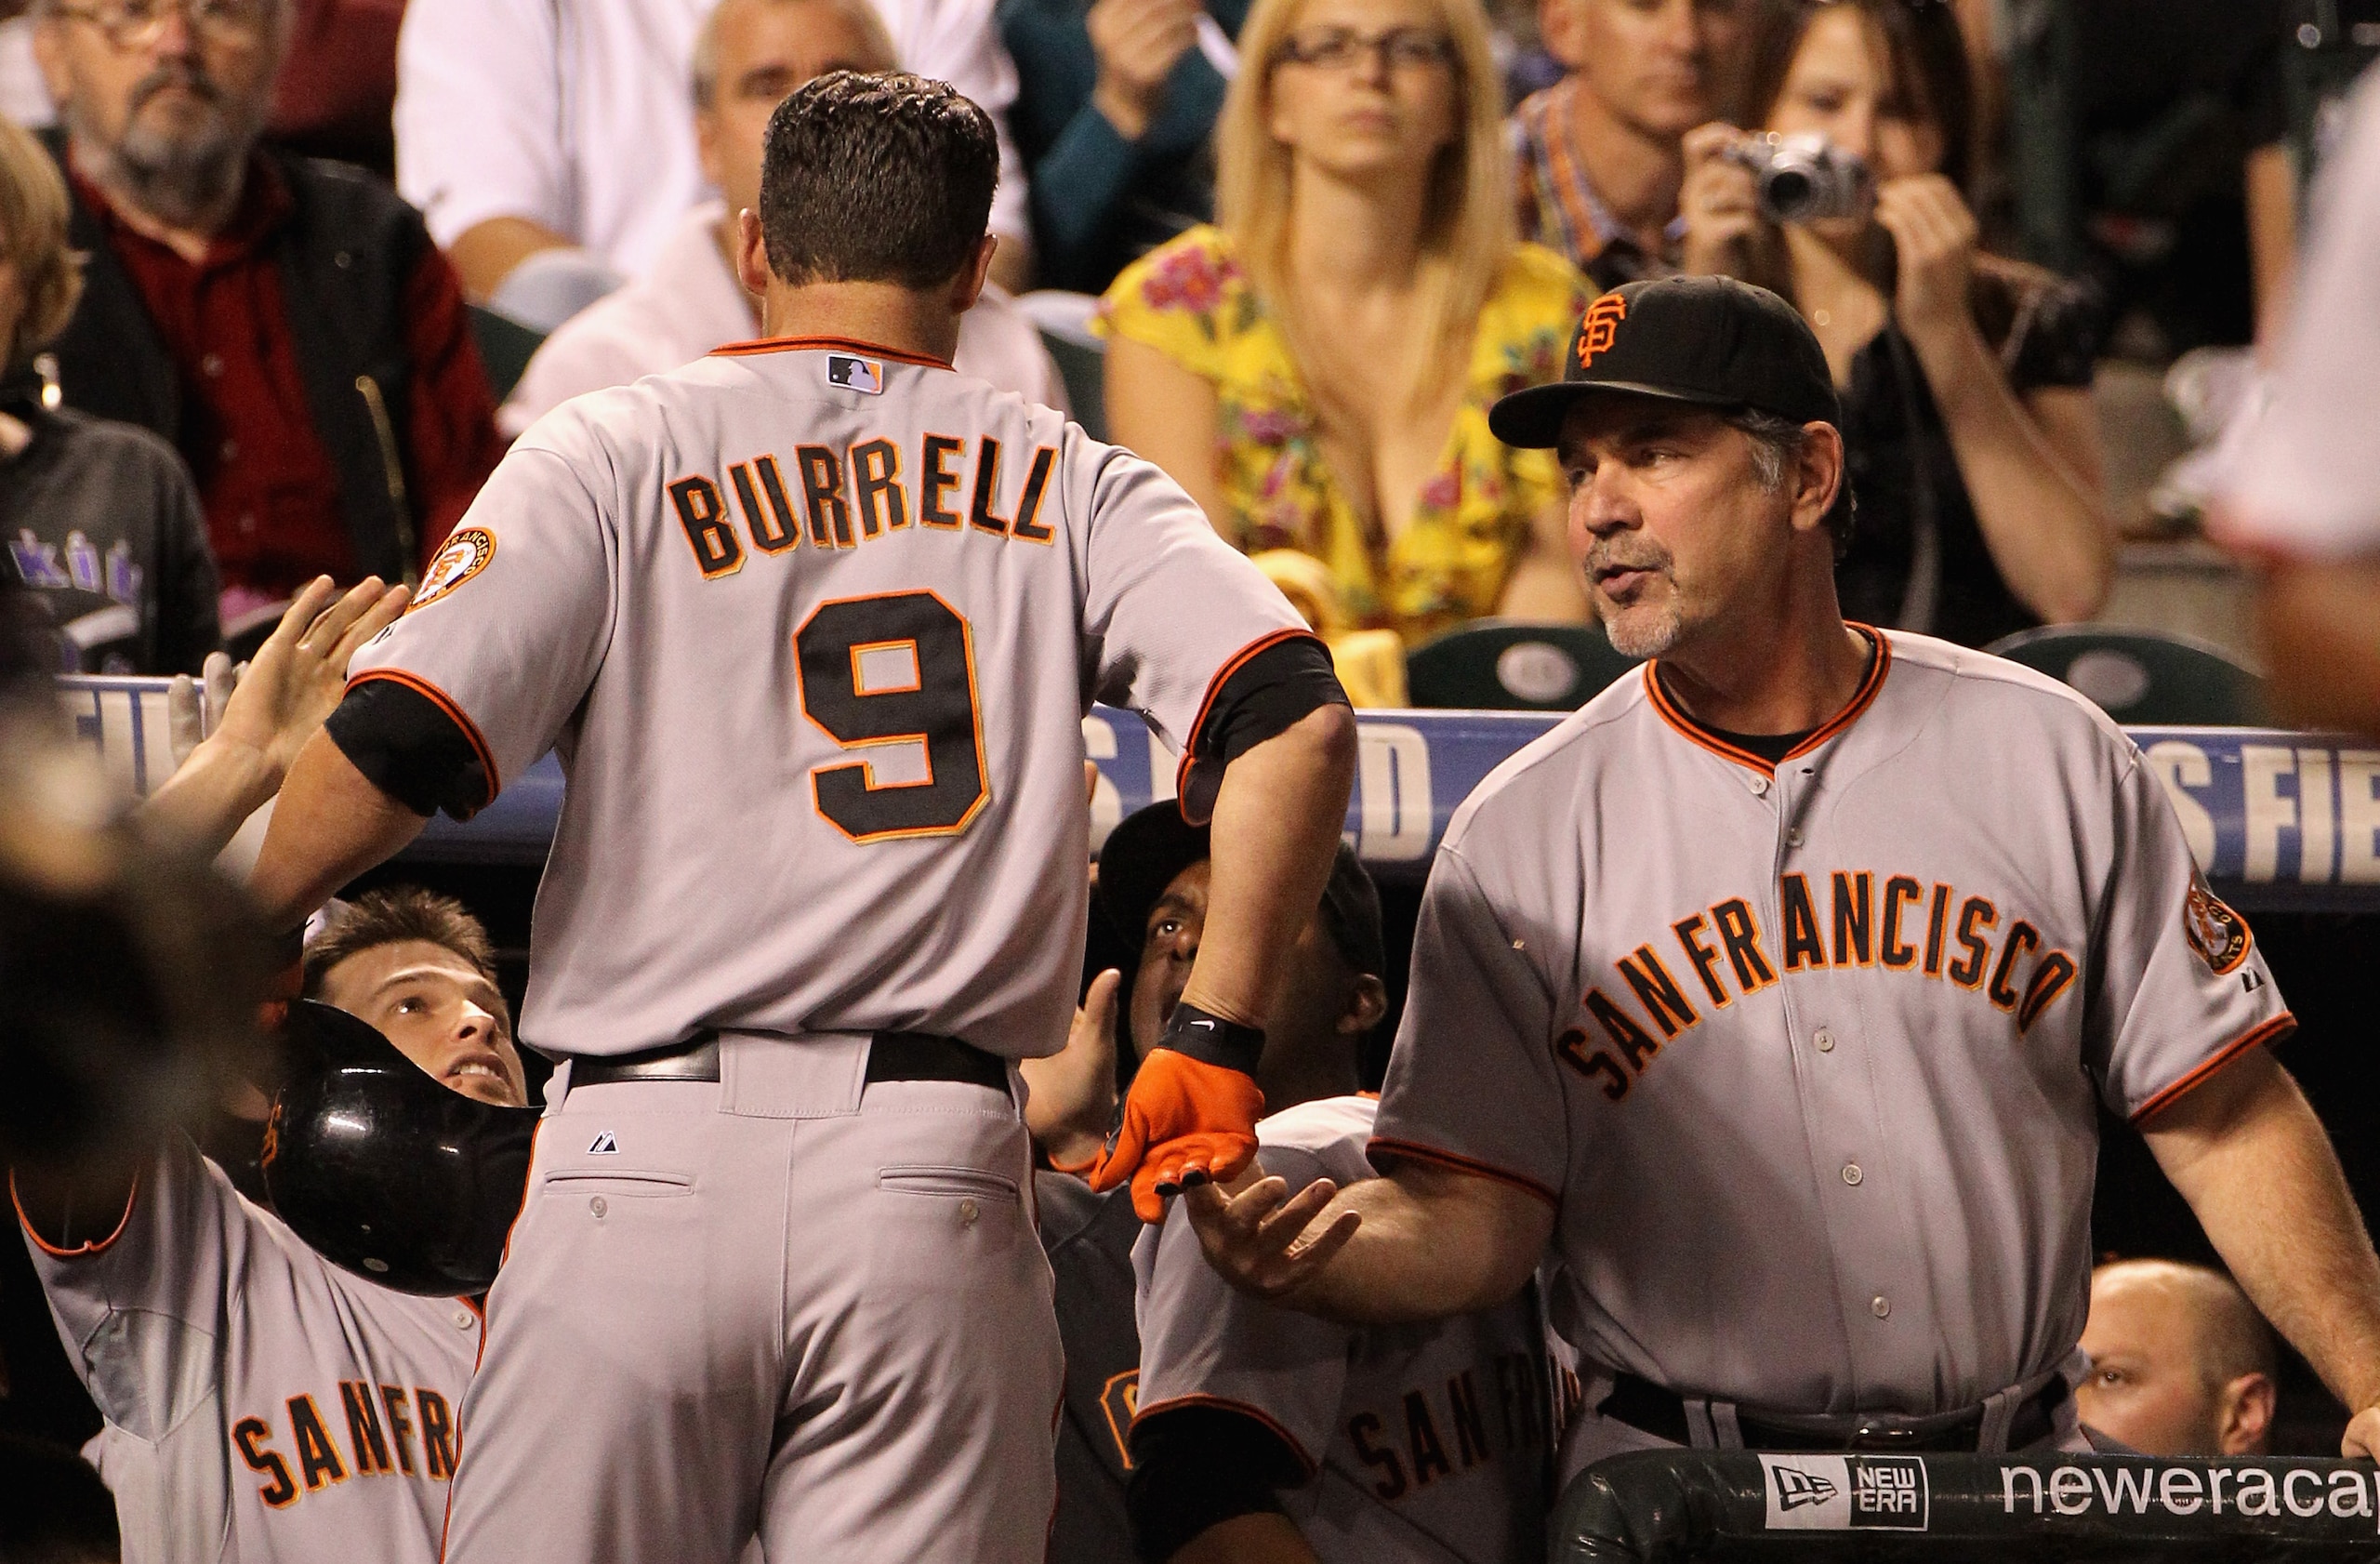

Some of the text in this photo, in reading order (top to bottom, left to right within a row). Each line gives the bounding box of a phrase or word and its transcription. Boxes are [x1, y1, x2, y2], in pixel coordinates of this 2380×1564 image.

[667, 431, 1059, 580] BURRELL
[792, 588, 991, 845] 9
[1556, 942, 1703, 1104] SAN
[1672, 870, 2079, 1038] FRANCISCO
[231, 1379, 396, 1510] SAN
[1346, 1364, 1491, 1500] SAN
[1856, 1466, 1916, 1489] NEW
[1858, 1489, 1918, 1514] ERA
[1999, 1465, 2380, 1535] neweraca
